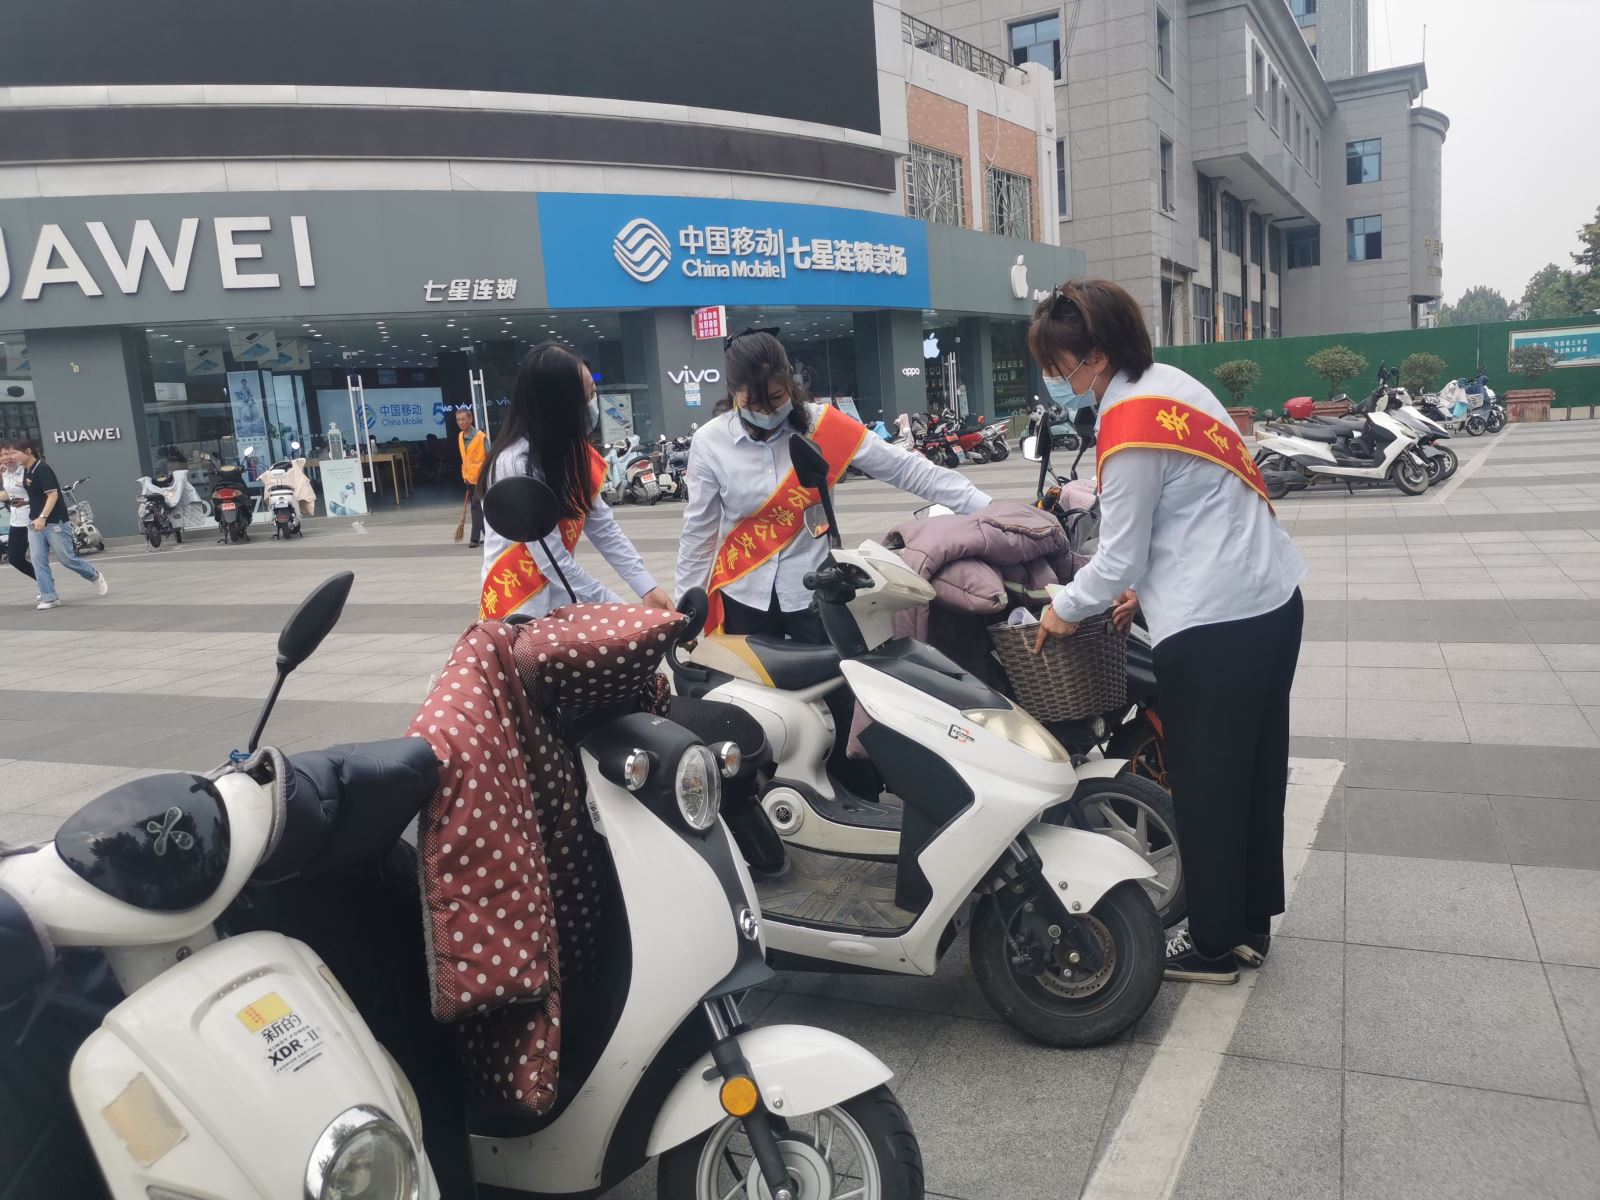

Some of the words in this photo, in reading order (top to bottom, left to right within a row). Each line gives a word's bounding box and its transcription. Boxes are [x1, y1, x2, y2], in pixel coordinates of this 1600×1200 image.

[678, 224, 779, 257] 中国移动
[0, 214, 316, 301] AWEI
[786, 236, 907, 276] 七星连锁卖场
[682, 258, 730, 278] China
[731, 260, 780, 278] Mobile
[423, 278, 518, 302] 七星连锁
[667, 364, 720, 384] vivo
[902, 367, 920, 377] oppo
[379, 402, 422, 418] 中国移动
[381, 418, 402, 427] China
[402, 416, 423, 426] Mobile
[54, 427, 121, 444] HUAWEI
[261, 1013, 302, 1043] 新的
